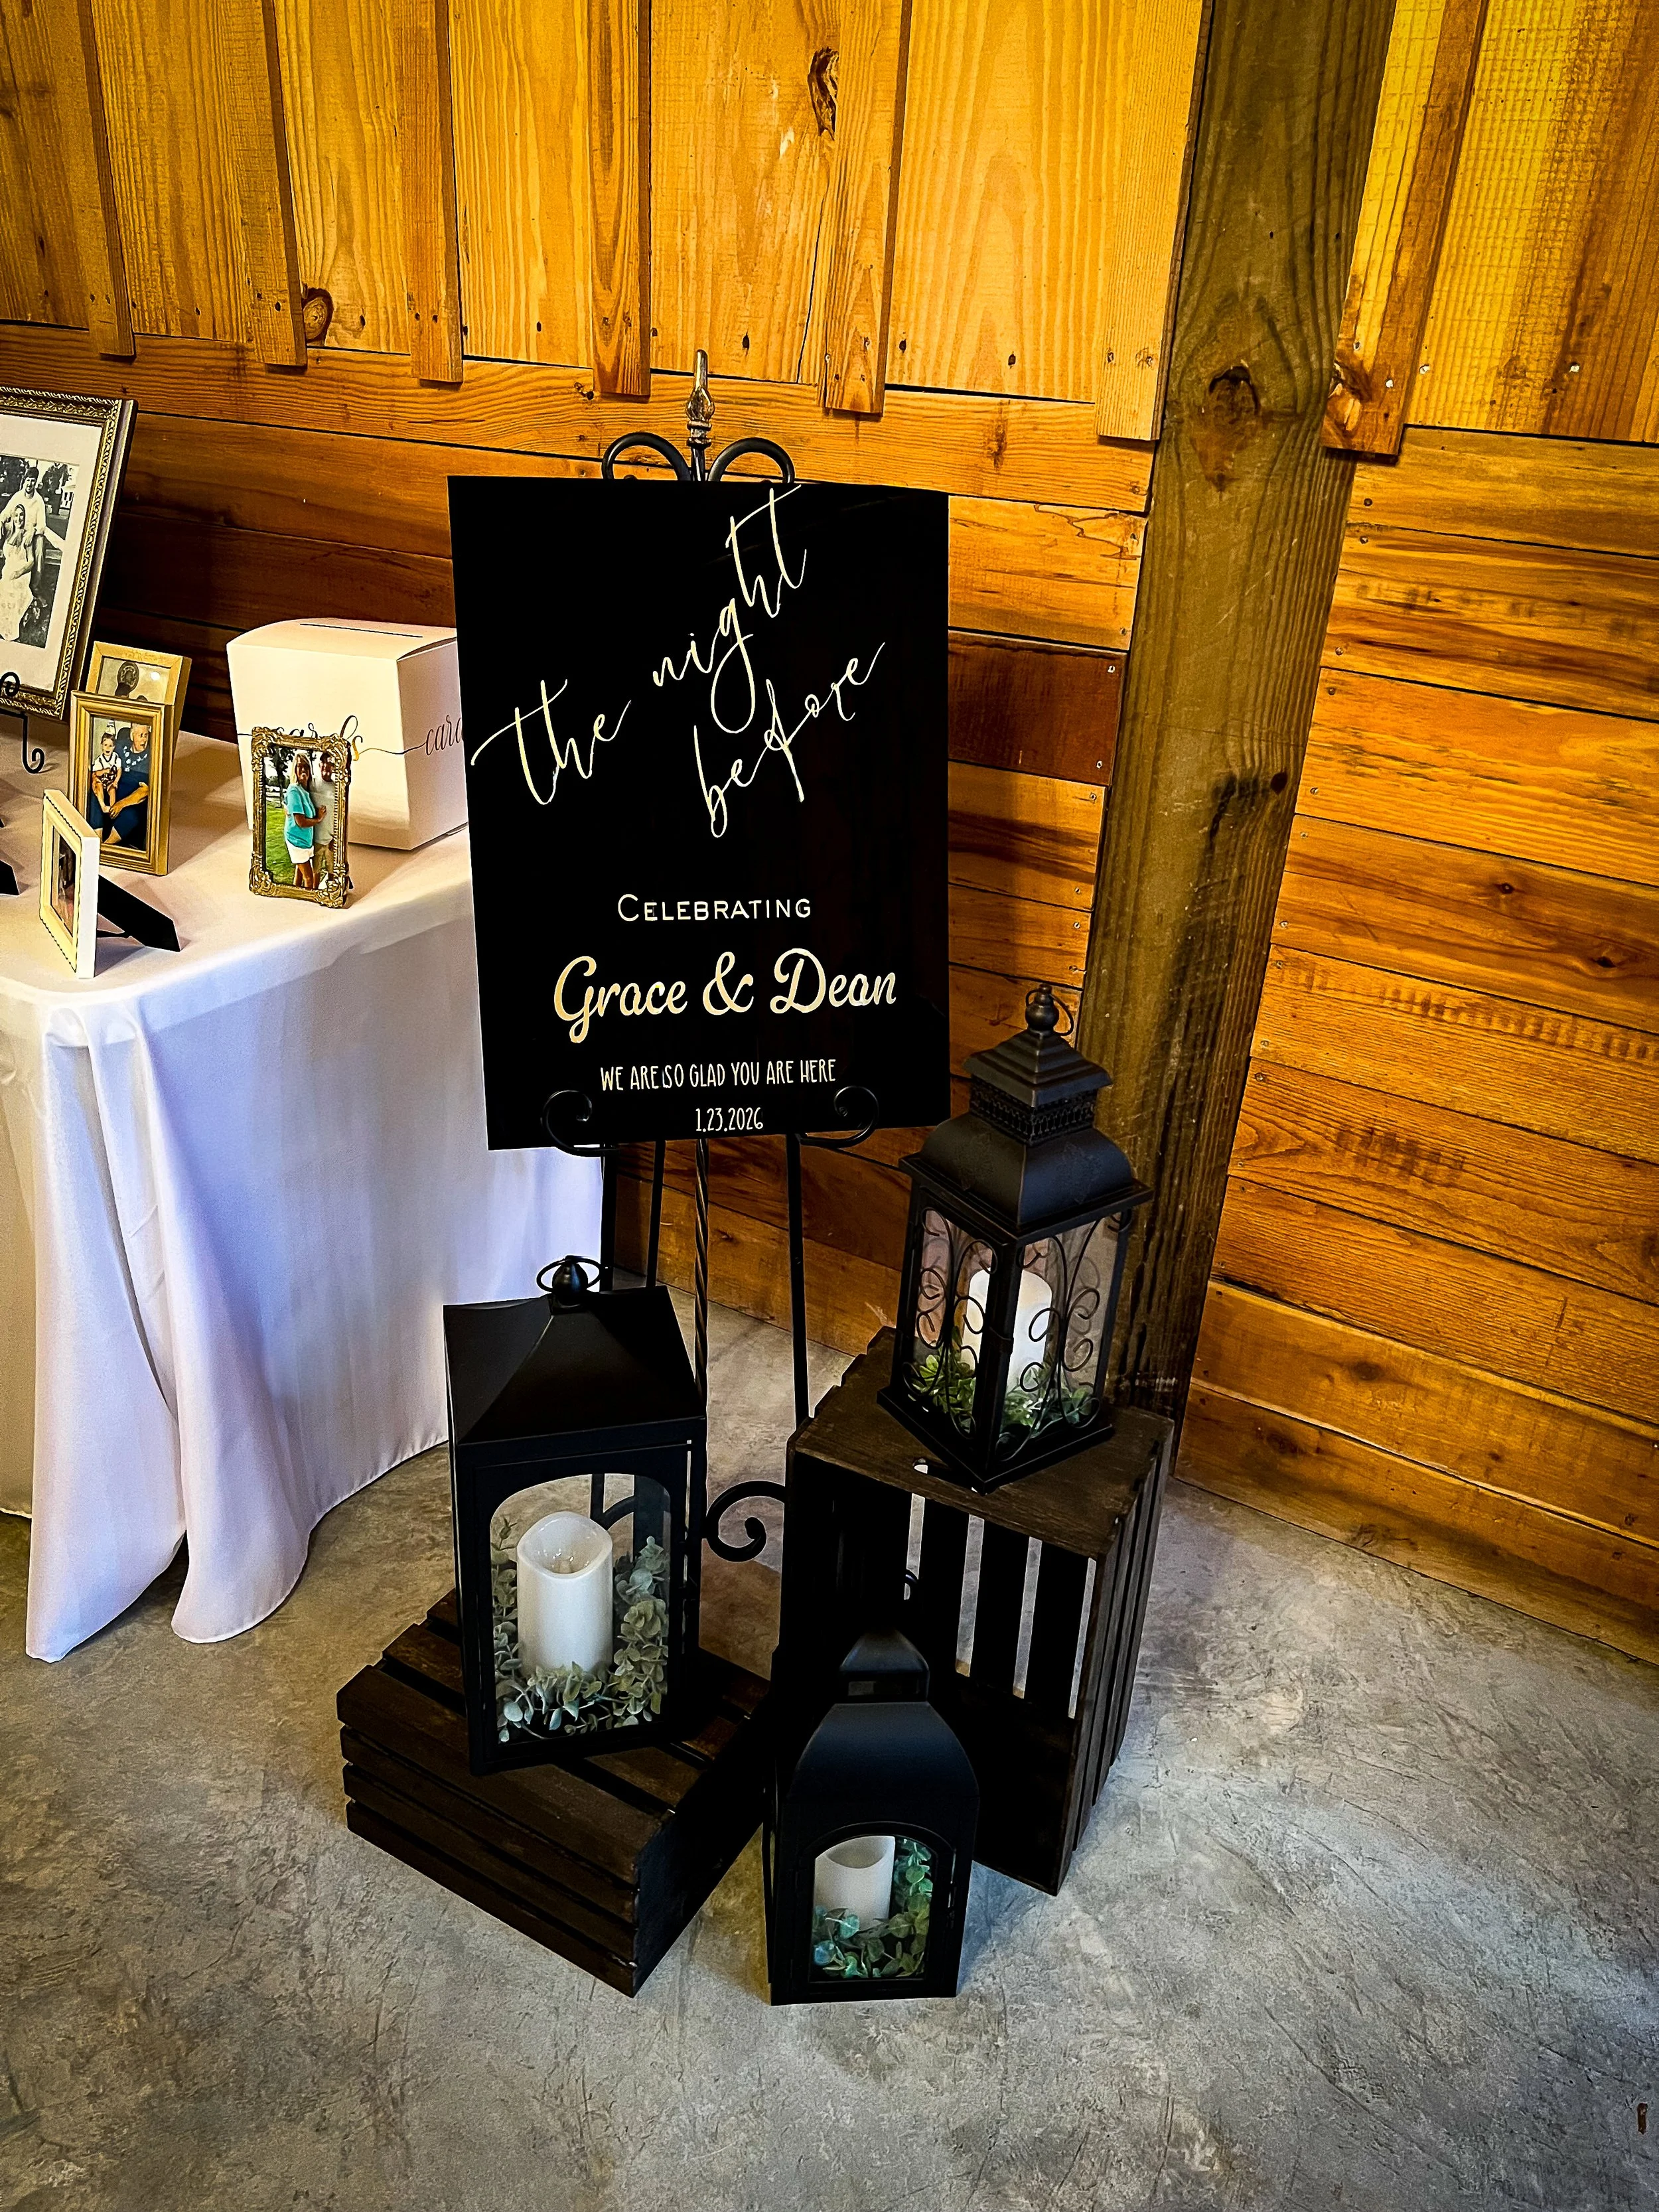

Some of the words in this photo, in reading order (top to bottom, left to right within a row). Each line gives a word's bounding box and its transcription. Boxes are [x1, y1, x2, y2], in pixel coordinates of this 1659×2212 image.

[470, 679, 631, 805] the
[652, 484, 807, 734] night
[694, 642, 885, 838] before
[553, 956, 688, 1044] Grace
[702, 951, 755, 1015] &
[770, 948, 897, 1014] Dean
[600, 1066, 624, 1091] WE
[630, 1065, 660, 1090] ARE
[663, 1063, 684, 1088] SO
[689, 1063, 725, 1088] GLAD
[731, 1061, 760, 1086] YOU
[766, 1060, 794, 1084] ARE
[800, 1059, 836, 1083] HERE
[695, 1106, 764, 1133] 1.23.2026
